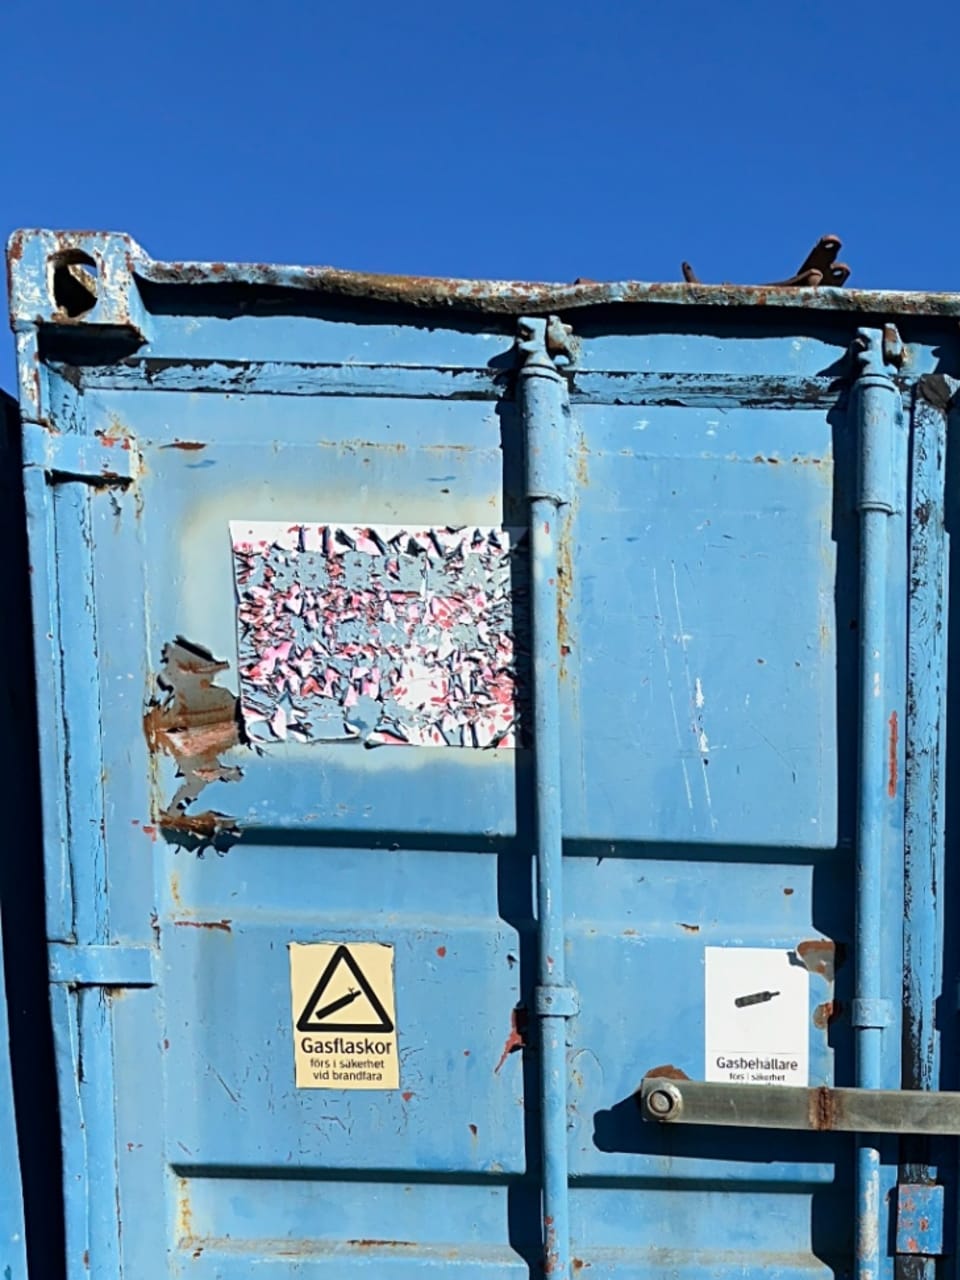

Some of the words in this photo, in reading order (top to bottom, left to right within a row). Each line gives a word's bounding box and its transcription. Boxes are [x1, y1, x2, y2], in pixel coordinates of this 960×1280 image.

[300, 1037, 392, 1054] Gasflaskor
[313, 1070, 330, 1080] vid
[332, 1070, 383, 1081] brandfara
